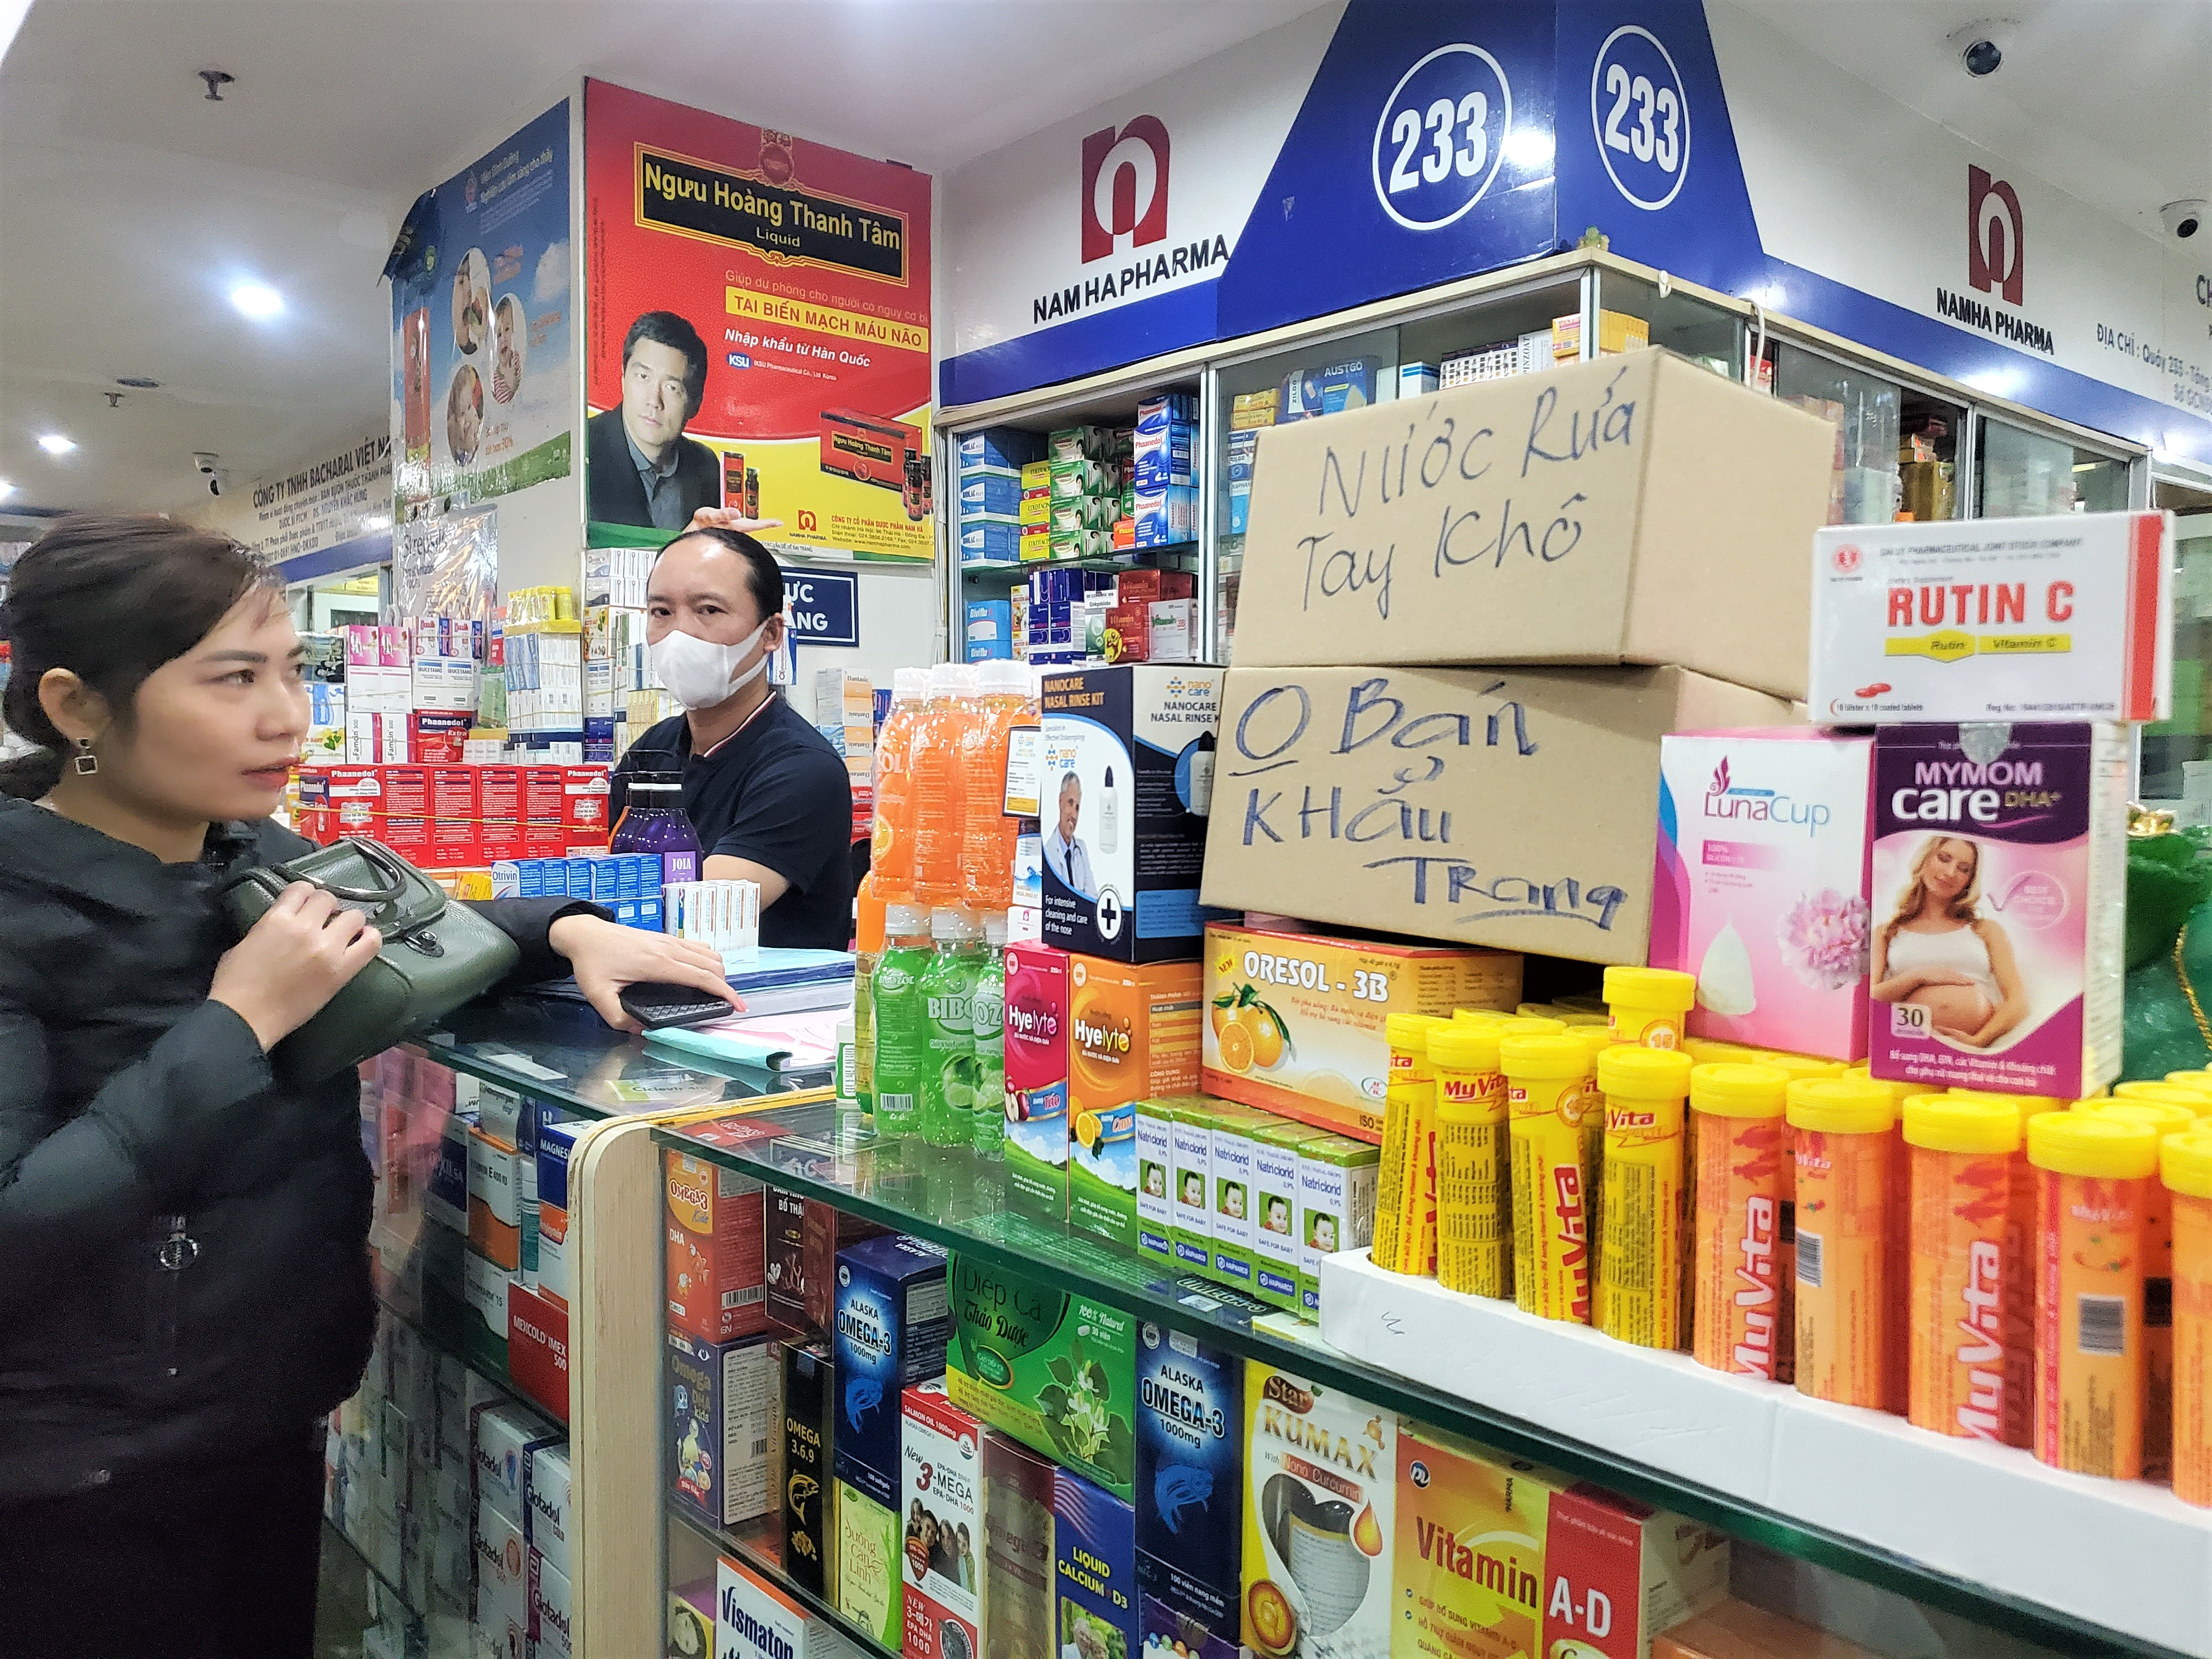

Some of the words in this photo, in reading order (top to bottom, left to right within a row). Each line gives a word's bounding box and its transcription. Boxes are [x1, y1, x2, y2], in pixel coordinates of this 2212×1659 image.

[1605, 64, 1678, 172] 233
[1389, 92, 1487, 194] 233
[645, 161, 707, 204] Ngưu
[714, 180, 782, 226] Hoàng
[789, 200, 853, 242] Thanh
[858, 216, 900, 249] Tâm
[756, 226, 800, 248] Liquid
[809, 289, 828, 301] cho
[735, 296, 757, 313] TAI
[764, 301, 799, 321] BIẾN
[806, 311, 849, 331] MẠCH
[855, 320, 886, 339] MÁU
[891, 328, 921, 346] NÃO
[1995, 311, 2054, 355] PHARMA
[725, 328, 758, 346] Nhập
[762, 334, 793, 352] khẩu
[797, 342, 809, 355] từ
[811, 345, 835, 361] Hàn
[839, 351, 871, 368] Quốc
[2097, 323, 2114, 349] ĐỊA
[729, 355, 749, 368] KSU
[767, 363, 802, 376] Pharmaceutical
[822, 373, 837, 381] Korea
[1323, 360, 1363, 379] AUSTGO
[1135, 436, 1163, 449] Phaanedol
[253, 483, 274, 509] CÔNG
[276, 482, 285, 501] TY
[287, 472, 308, 497] TNHH
[310, 452, 353, 488] BACHARAL
[1136, 499, 1162, 511] Phaanedol
[1296, 532, 1396, 621] Tay
[1887, 582, 2026, 627] RUTIN
[2046, 580, 2075, 622] C
[1931, 640, 1966, 651] Rutin
[1993, 639, 2042, 649] Vitamin
[1045, 677, 1084, 692] NANOCARE
[1045, 694, 1068, 709] NASAL
[1092, 692, 1104, 706] KIT
[1164, 702, 1217, 712] NANOCARE
[421, 718, 464, 727] Phaanedol
[1150, 713, 1183, 723] NASAL
[1184, 712, 1212, 723] RINSE
[1915, 761, 2043, 786] MYMOM
[1703, 791, 1830, 838] LunaCup
[1892, 787, 2001, 822] care
[493, 871, 517, 882] Otrivin
[672, 857, 692, 872] JOIA
[1045, 894, 1054, 906] For
[1244, 950, 1330, 992] ORESOL
[1353, 969, 1389, 1002] 3B
[1009, 1004, 1057, 1035] Hyelyte
[1897, 1007, 1924, 1028] 30
[1075, 1018, 1129, 1052] Hyelyte
[1044, 1092, 1060, 1110] Táo
[1359, 1114, 1375, 1130] ISO
[1137, 1129, 1167, 1148] Natriclorid
[1174, 1137, 1207, 1156] Natriclorid
[1215, 1146, 1249, 1166] Natriclorid
[488, 1165, 493, 1179] E
[1256, 1159, 1294, 1180] Natriclorid
[1302, 1174, 1341, 1196] Natriclorid
[778, 1199, 788, 1211] BỔ
[669, 1228, 685, 1246] DHA
[850, 1299, 879, 1321] ALASKA
[1079, 1304, 1098, 1321] 100%
[1099, 1311, 1125, 1331] Natural
[513, 1314, 545, 1344] MEXCOLD
[548, 1336, 566, 1357] IMEX
[838, 1309, 891, 1355] OMEGA-3
[997, 1314, 1029, 1350] Dược
[553, 1355, 566, 1372] 500
[850, 1342, 877, 1364] 1000mg
[1160, 1364, 1205, 1395] ALASKA
[1265, 1376, 1310, 1410] Star
[694, 1405, 709, 1424] kids
[1142, 1378, 1226, 1439] OMEGA-3
[787, 1417, 821, 1448] OMEGA
[905, 1406, 926, 1421] SALMON
[926, 1416, 935, 1426] OIL
[936, 1421, 956, 1438] 1000mg
[1159, 1418, 1202, 1449] 1000mg
[791, 1438, 815, 1464] 3.6.9
[1263, 1403, 1378, 1481] KUMAX
[904, 1445, 923, 1464] New
[916, 1462, 973, 1504] 3-MEGA
[1265, 1451, 1280, 1465] With
[1283, 1452, 1309, 1478] Nano
[1312, 1466, 1362, 1500] Curcumin
[960, 1502, 974, 1515] 1000
[912, 1559, 924, 1573] 1000
[1073, 1546, 1111, 1578] LIQUID
[1415, 1515, 1538, 1609] Vitamin
[1058, 1559, 1105, 1596] CALCIUM
[1112, 1589, 1128, 1609] D3
[1170, 1572, 1180, 1584] 100
[1181, 1577, 1194, 1590] viên
[1194, 1584, 1209, 1601] nang
[906, 1594, 925, 1611] NEW
[1549, 1575, 1611, 1639] A-D
[907, 1619, 919, 1635] EPA
[919, 1624, 933, 1642] DHA
[907, 1630, 930, 1655] 1000
